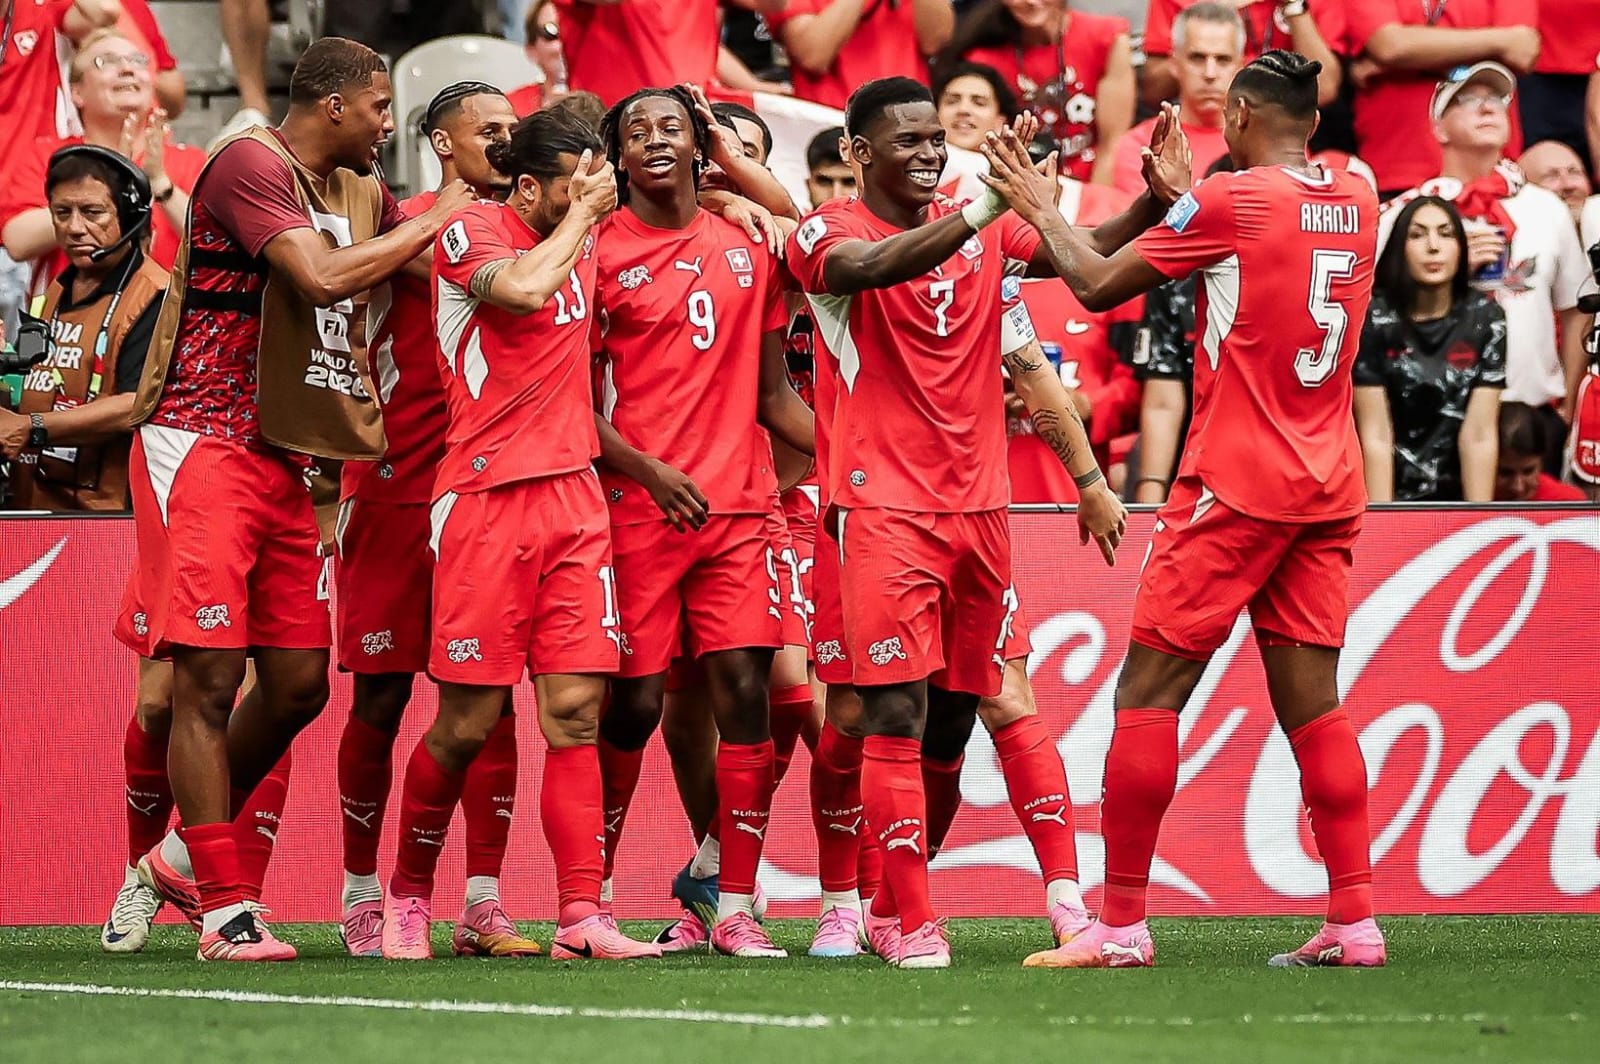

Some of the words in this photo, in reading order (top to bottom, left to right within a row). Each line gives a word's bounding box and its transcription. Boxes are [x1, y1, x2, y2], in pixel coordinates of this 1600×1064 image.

[1301, 203, 1359, 234] AKANJI
[554, 268, 587, 326] 13
[688, 290, 716, 351] 9
[929, 279, 956, 337] 7
[1293, 249, 1357, 388] 5
[597, 566, 621, 627] 1
